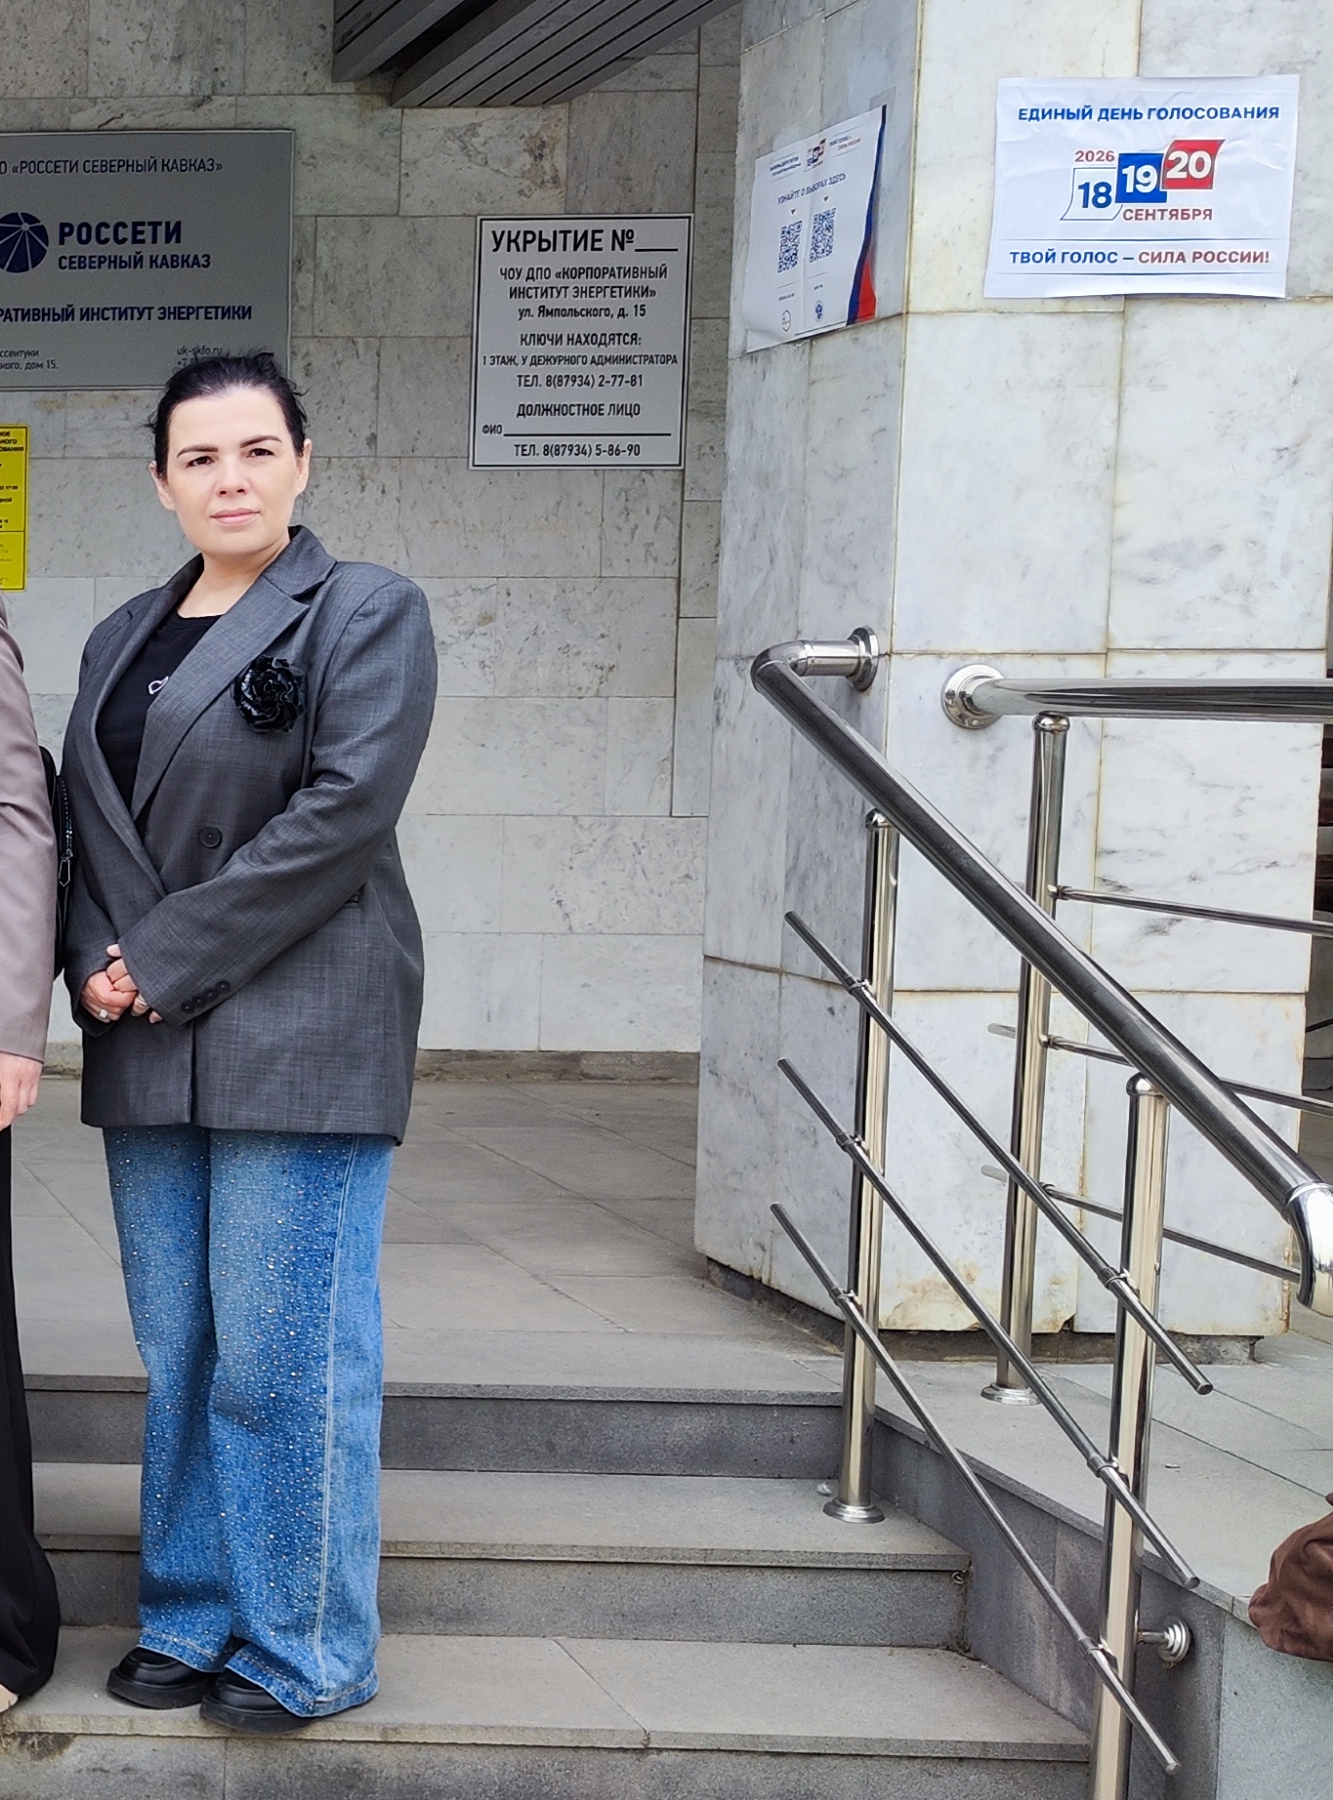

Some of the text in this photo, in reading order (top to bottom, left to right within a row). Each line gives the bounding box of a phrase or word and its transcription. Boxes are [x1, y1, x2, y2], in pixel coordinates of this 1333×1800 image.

[1018, 105, 1280, 121] ЕДИНЫЙ ДЕНЬ ГОЛОСОВАНИЯ
[1074, 150, 1115, 162] 2026
[12, 159, 79, 175] «РОССЕТИ
[83, 155, 157, 174] СЕВЕРНЫЙ
[161, 157, 223, 173] КАВКАЗ»
[1078, 150, 1212, 209] 18 19 20
[1122, 208, 1213, 221] СЕНТЯБРЯ
[58, 221, 182, 246] РОССЕТИ
[491, 229, 635, 252] УКРЫТИЕ №
[58, 250, 211, 270] СЕВЕРНЫЙ КАВКАЗ
[1009, 248, 1056, 264] ТВОЙ
[1061, 251, 1118, 264] ГОЛОС
[1139, 250, 1186, 264] СИЛА
[1191, 250, 1270, 263] РОССИИ!
[500, 263, 668, 281] ЧОУ ДПО «КОРПОРАТИВНЫЙ
[509, 285, 656, 299] ИНСТИТУТ ЭНЕРГЕТИКИ»
[79, 306, 154, 322] ИНСТИТУТ
[157, 305, 252, 321] ЭНЕРГЕТИКИ
[518, 304, 646, 321] ул. Ямпольского, д. 15
[520, 333, 642, 347] КЛЮЧИ НАХОДЯТСЯ:
[24, 362, 43, 371] дом
[489, 354, 519, 367] ЭТАЖ,
[521, 355, 528, 365] У
[530, 354, 587, 367] ДЕЖУРНОГО
[590, 353, 678, 366] АДМИНИСТРАТОРА
[516, 374, 643, 389] ТЕЛ. 8(87934) 2-77-81
[516, 403, 641, 418] ДОЛЖНОСТНОЕ ЛИЦО
[482, 424, 502, 435] ФИО
[514, 443, 641, 458] ТЕЛ. 8(87934) 5-86-90
